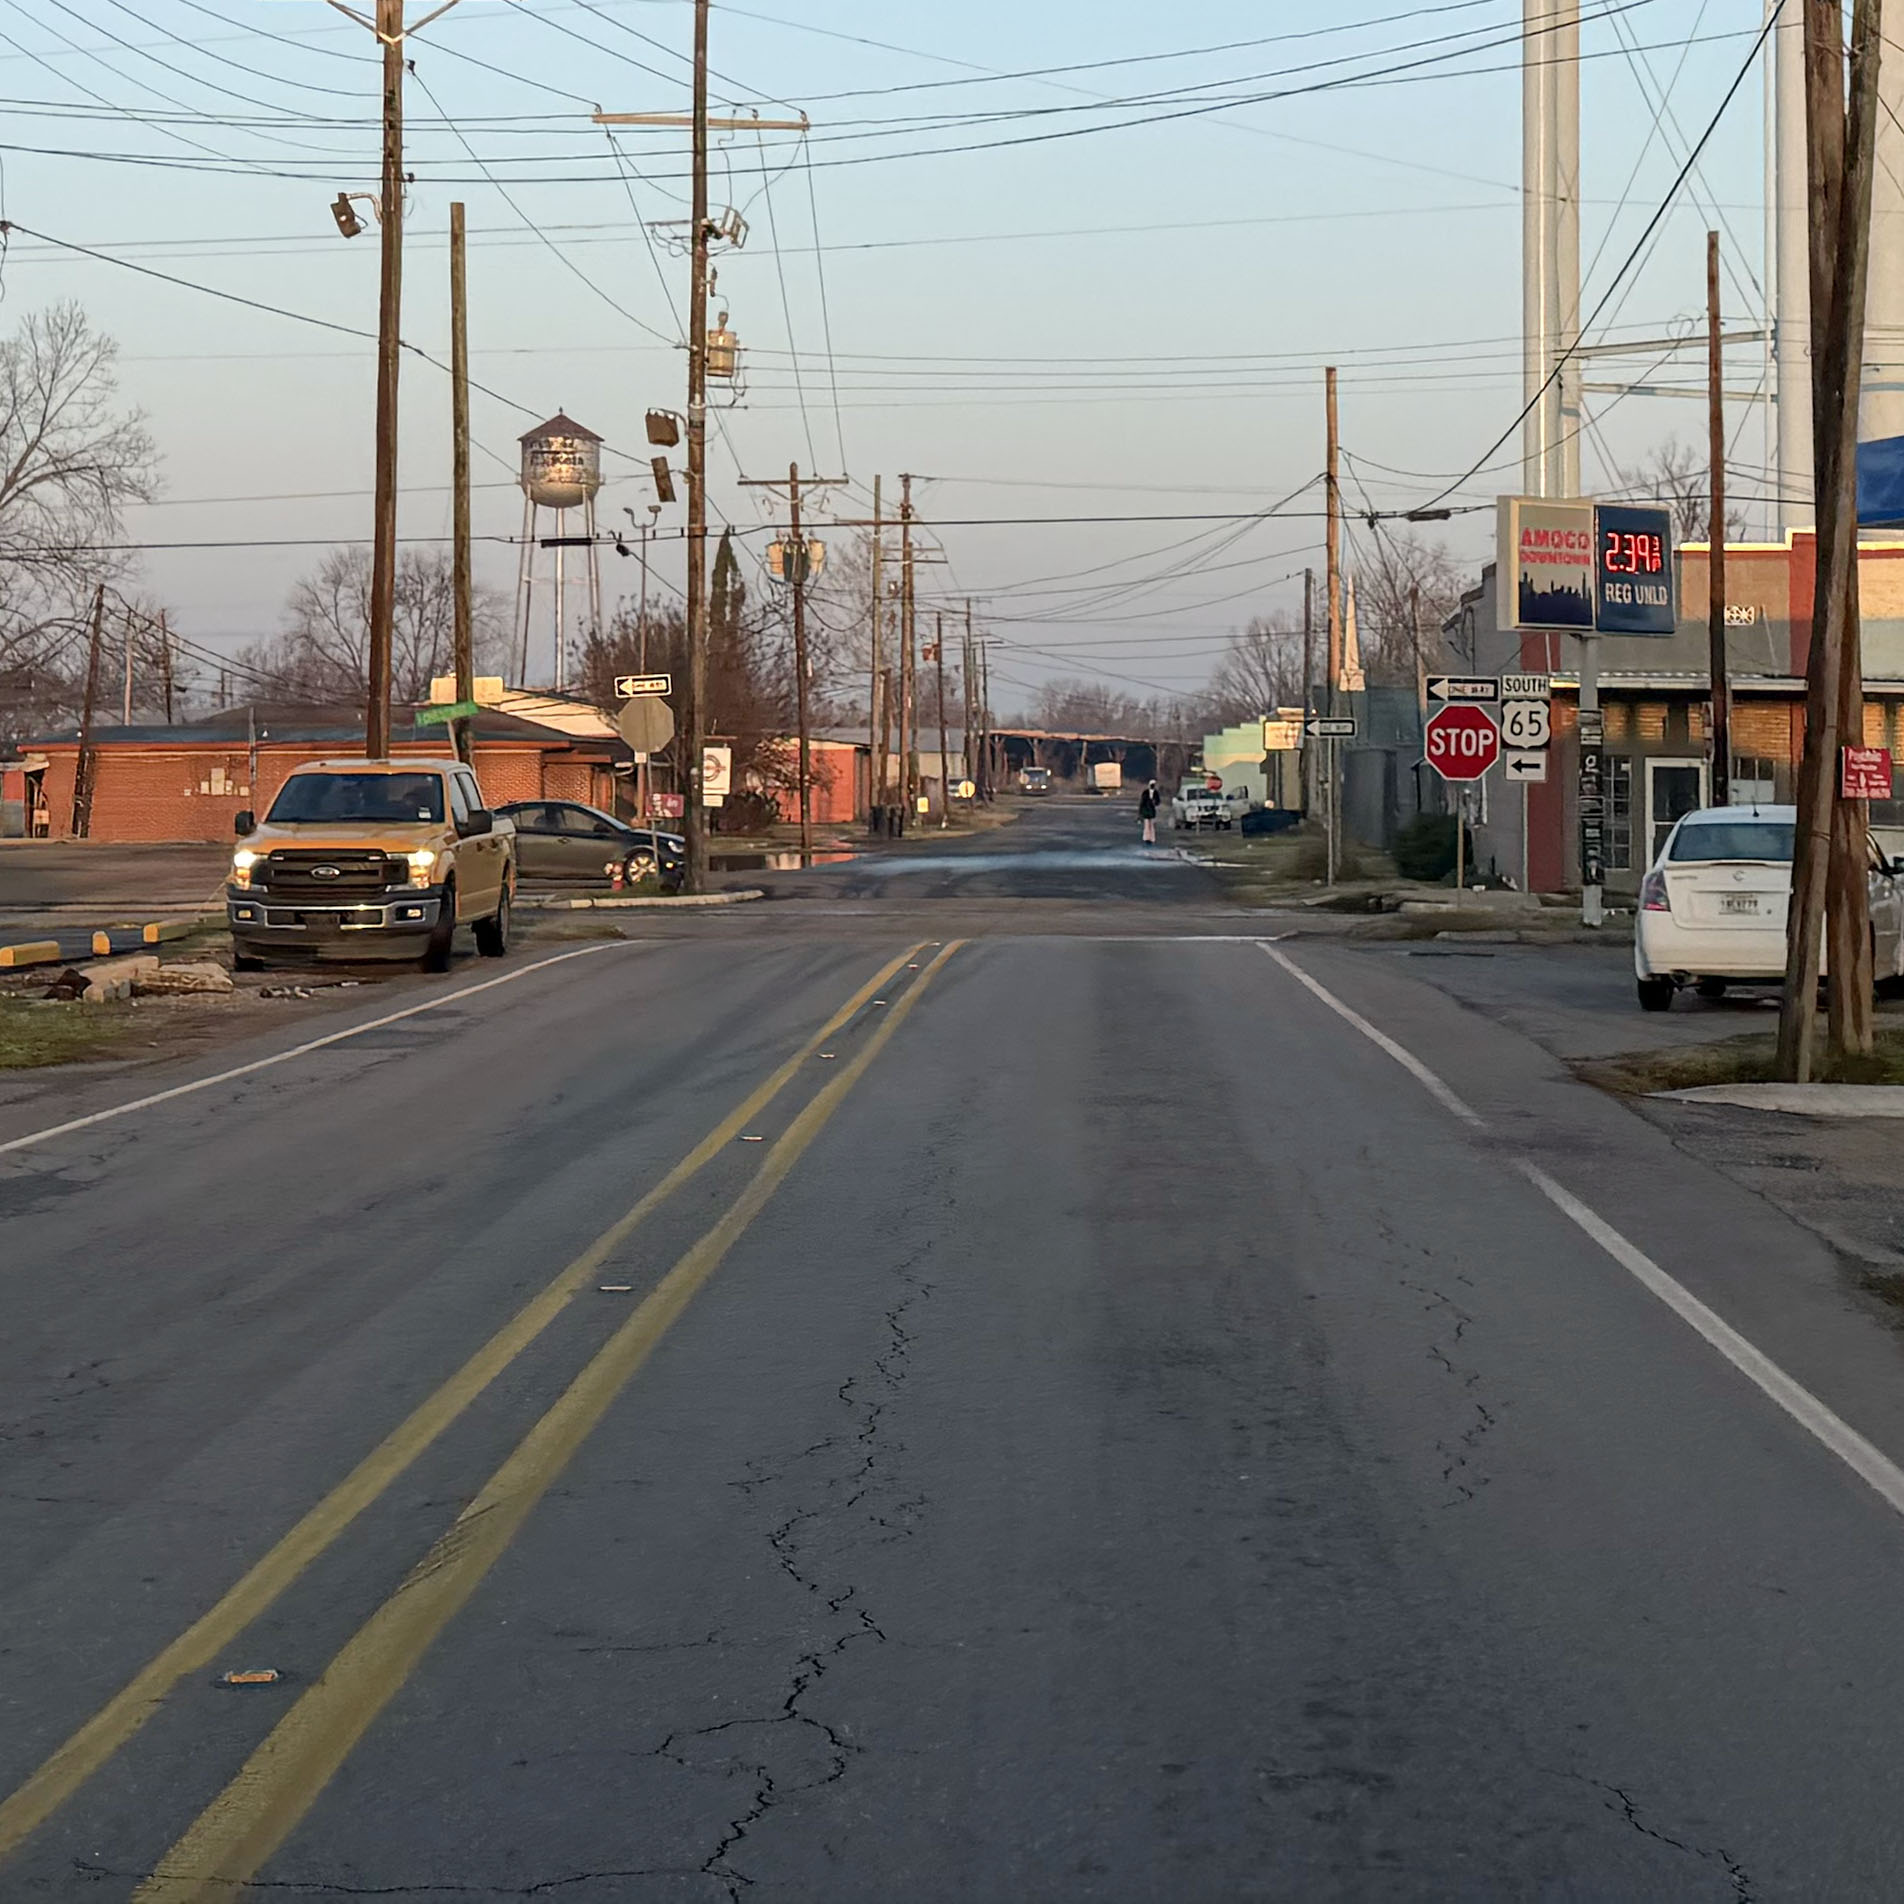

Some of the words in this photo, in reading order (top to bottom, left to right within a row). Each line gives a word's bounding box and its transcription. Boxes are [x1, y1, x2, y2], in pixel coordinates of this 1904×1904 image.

[1521, 527, 1590, 549] AMOCO
[1605, 582, 1632, 604] REG
[1635, 584, 1668, 605] UNLD
[1504, 678, 1547, 693] SOUTH
[1510, 710, 1542, 736] 65
[1430, 727, 1495, 757] STOP
